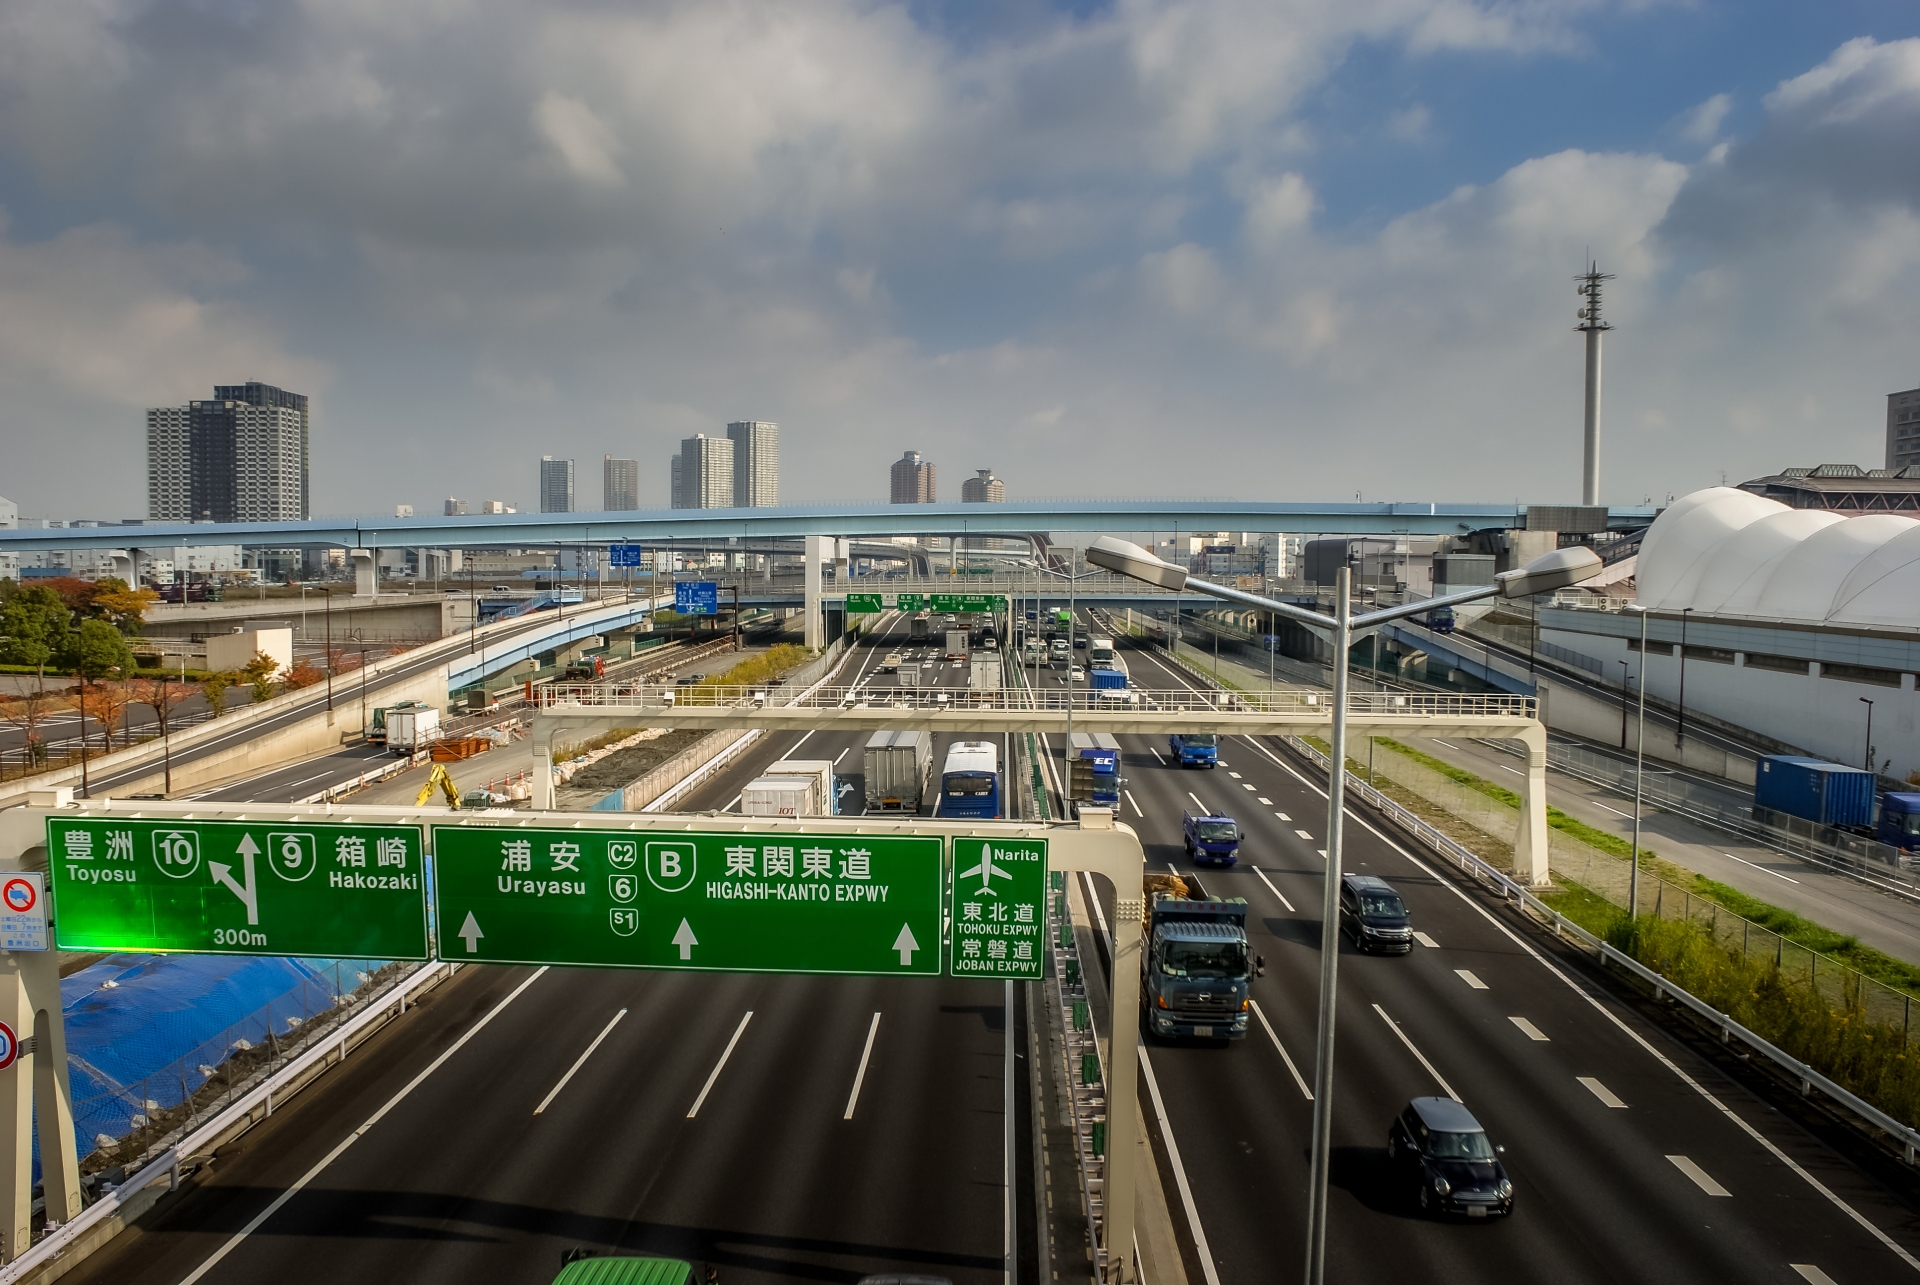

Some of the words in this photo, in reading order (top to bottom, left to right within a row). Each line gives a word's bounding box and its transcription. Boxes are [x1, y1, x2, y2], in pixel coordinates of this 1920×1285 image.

[1093, 757, 1114, 765] EC
[65, 830, 134, 862] 豊洲
[159, 839, 194, 865] 10
[281, 841, 303, 868] 9
[336, 836, 408, 868] 箱崎
[610, 844, 634, 862] C2
[994, 848, 1039, 861] Narita
[501, 840, 581, 873] 浦安
[660, 850, 682, 877] B
[724, 845, 872, 880] 東関東道
[66, 865, 137, 884] Toyosu
[330, 871, 418, 890] Hakozaki
[497, 876, 587, 896] Urayasu
[615, 878, 631, 898] 6
[706, 881, 831, 902] HIGASHI-KANTO
[835, 884, 889, 903] EXPWY
[614, 912, 633, 929] S1
[962, 901, 1035, 922] 東北道
[213, 928, 267, 946] 300m
[957, 923, 1000, 935] TOHOKU
[1002, 924, 1038, 935] EXPWY
[962, 938, 1034, 959] 常磐道
[956, 959, 994, 971] JOBAN
[997, 961, 1037, 972] EXPWY
